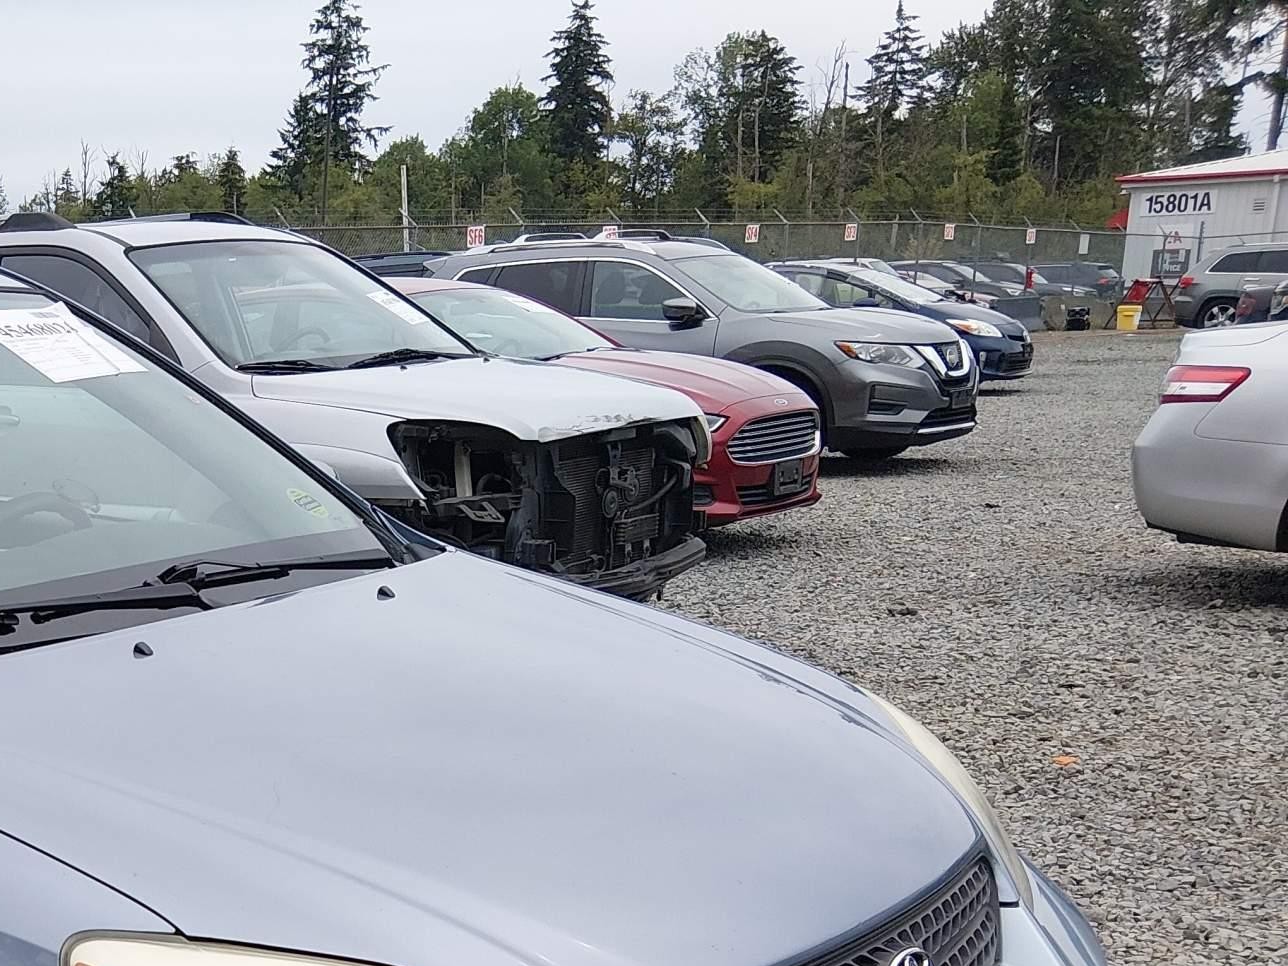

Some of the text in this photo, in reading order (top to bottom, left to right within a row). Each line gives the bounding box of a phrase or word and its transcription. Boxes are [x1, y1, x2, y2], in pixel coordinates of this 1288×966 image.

[1145, 192, 1211, 214] 15801A
[468, 229, 484, 245] SF6
[746, 226, 758, 240] SF4
